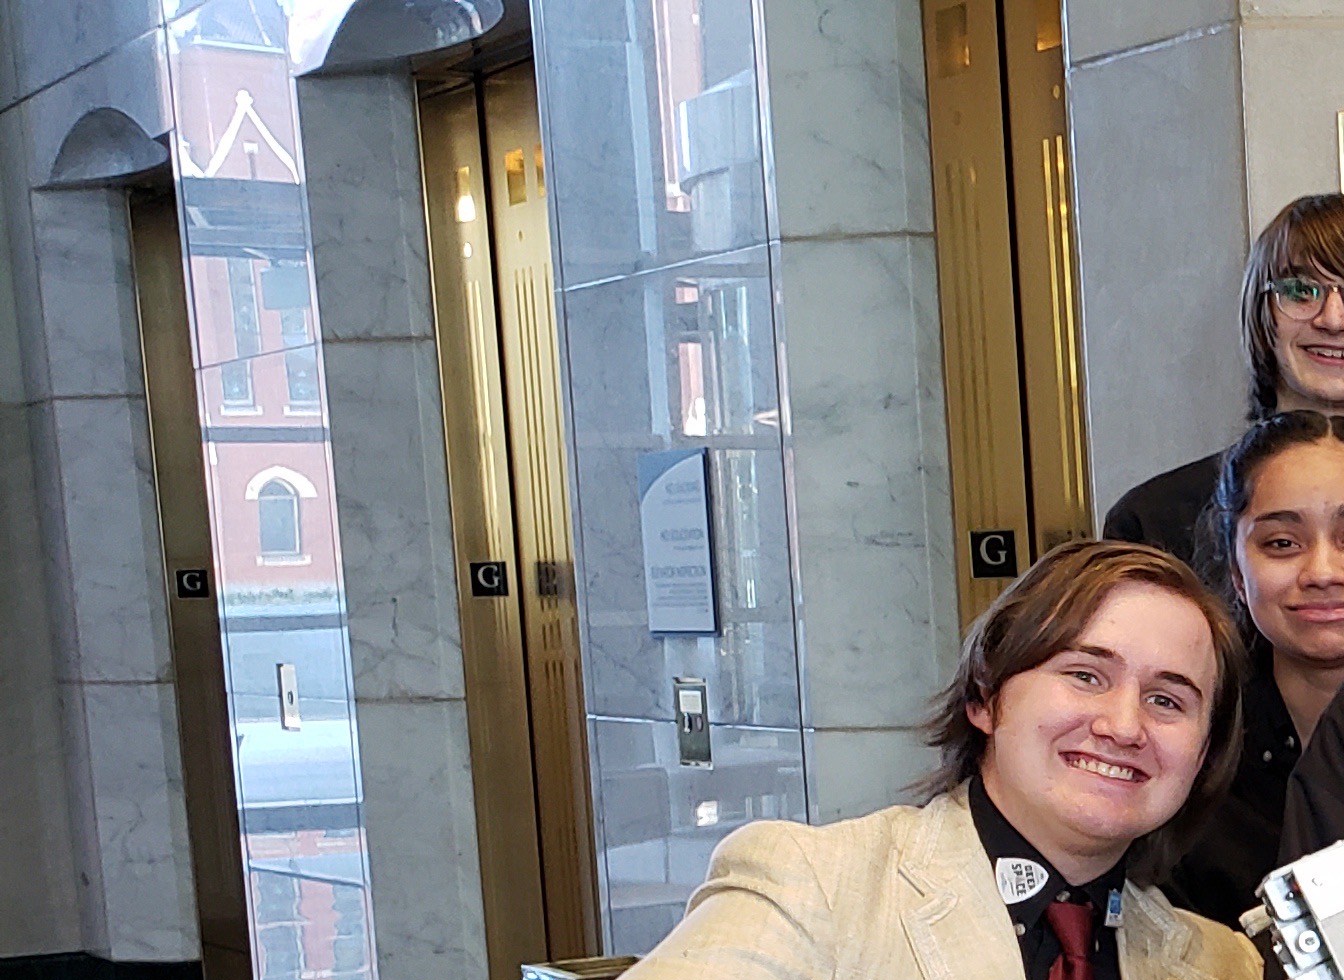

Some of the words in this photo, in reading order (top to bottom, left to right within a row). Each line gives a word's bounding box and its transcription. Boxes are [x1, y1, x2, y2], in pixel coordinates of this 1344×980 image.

[980, 534, 1007, 565] G
[183, 572, 201, 591] G
[477, 564, 500, 588] G
